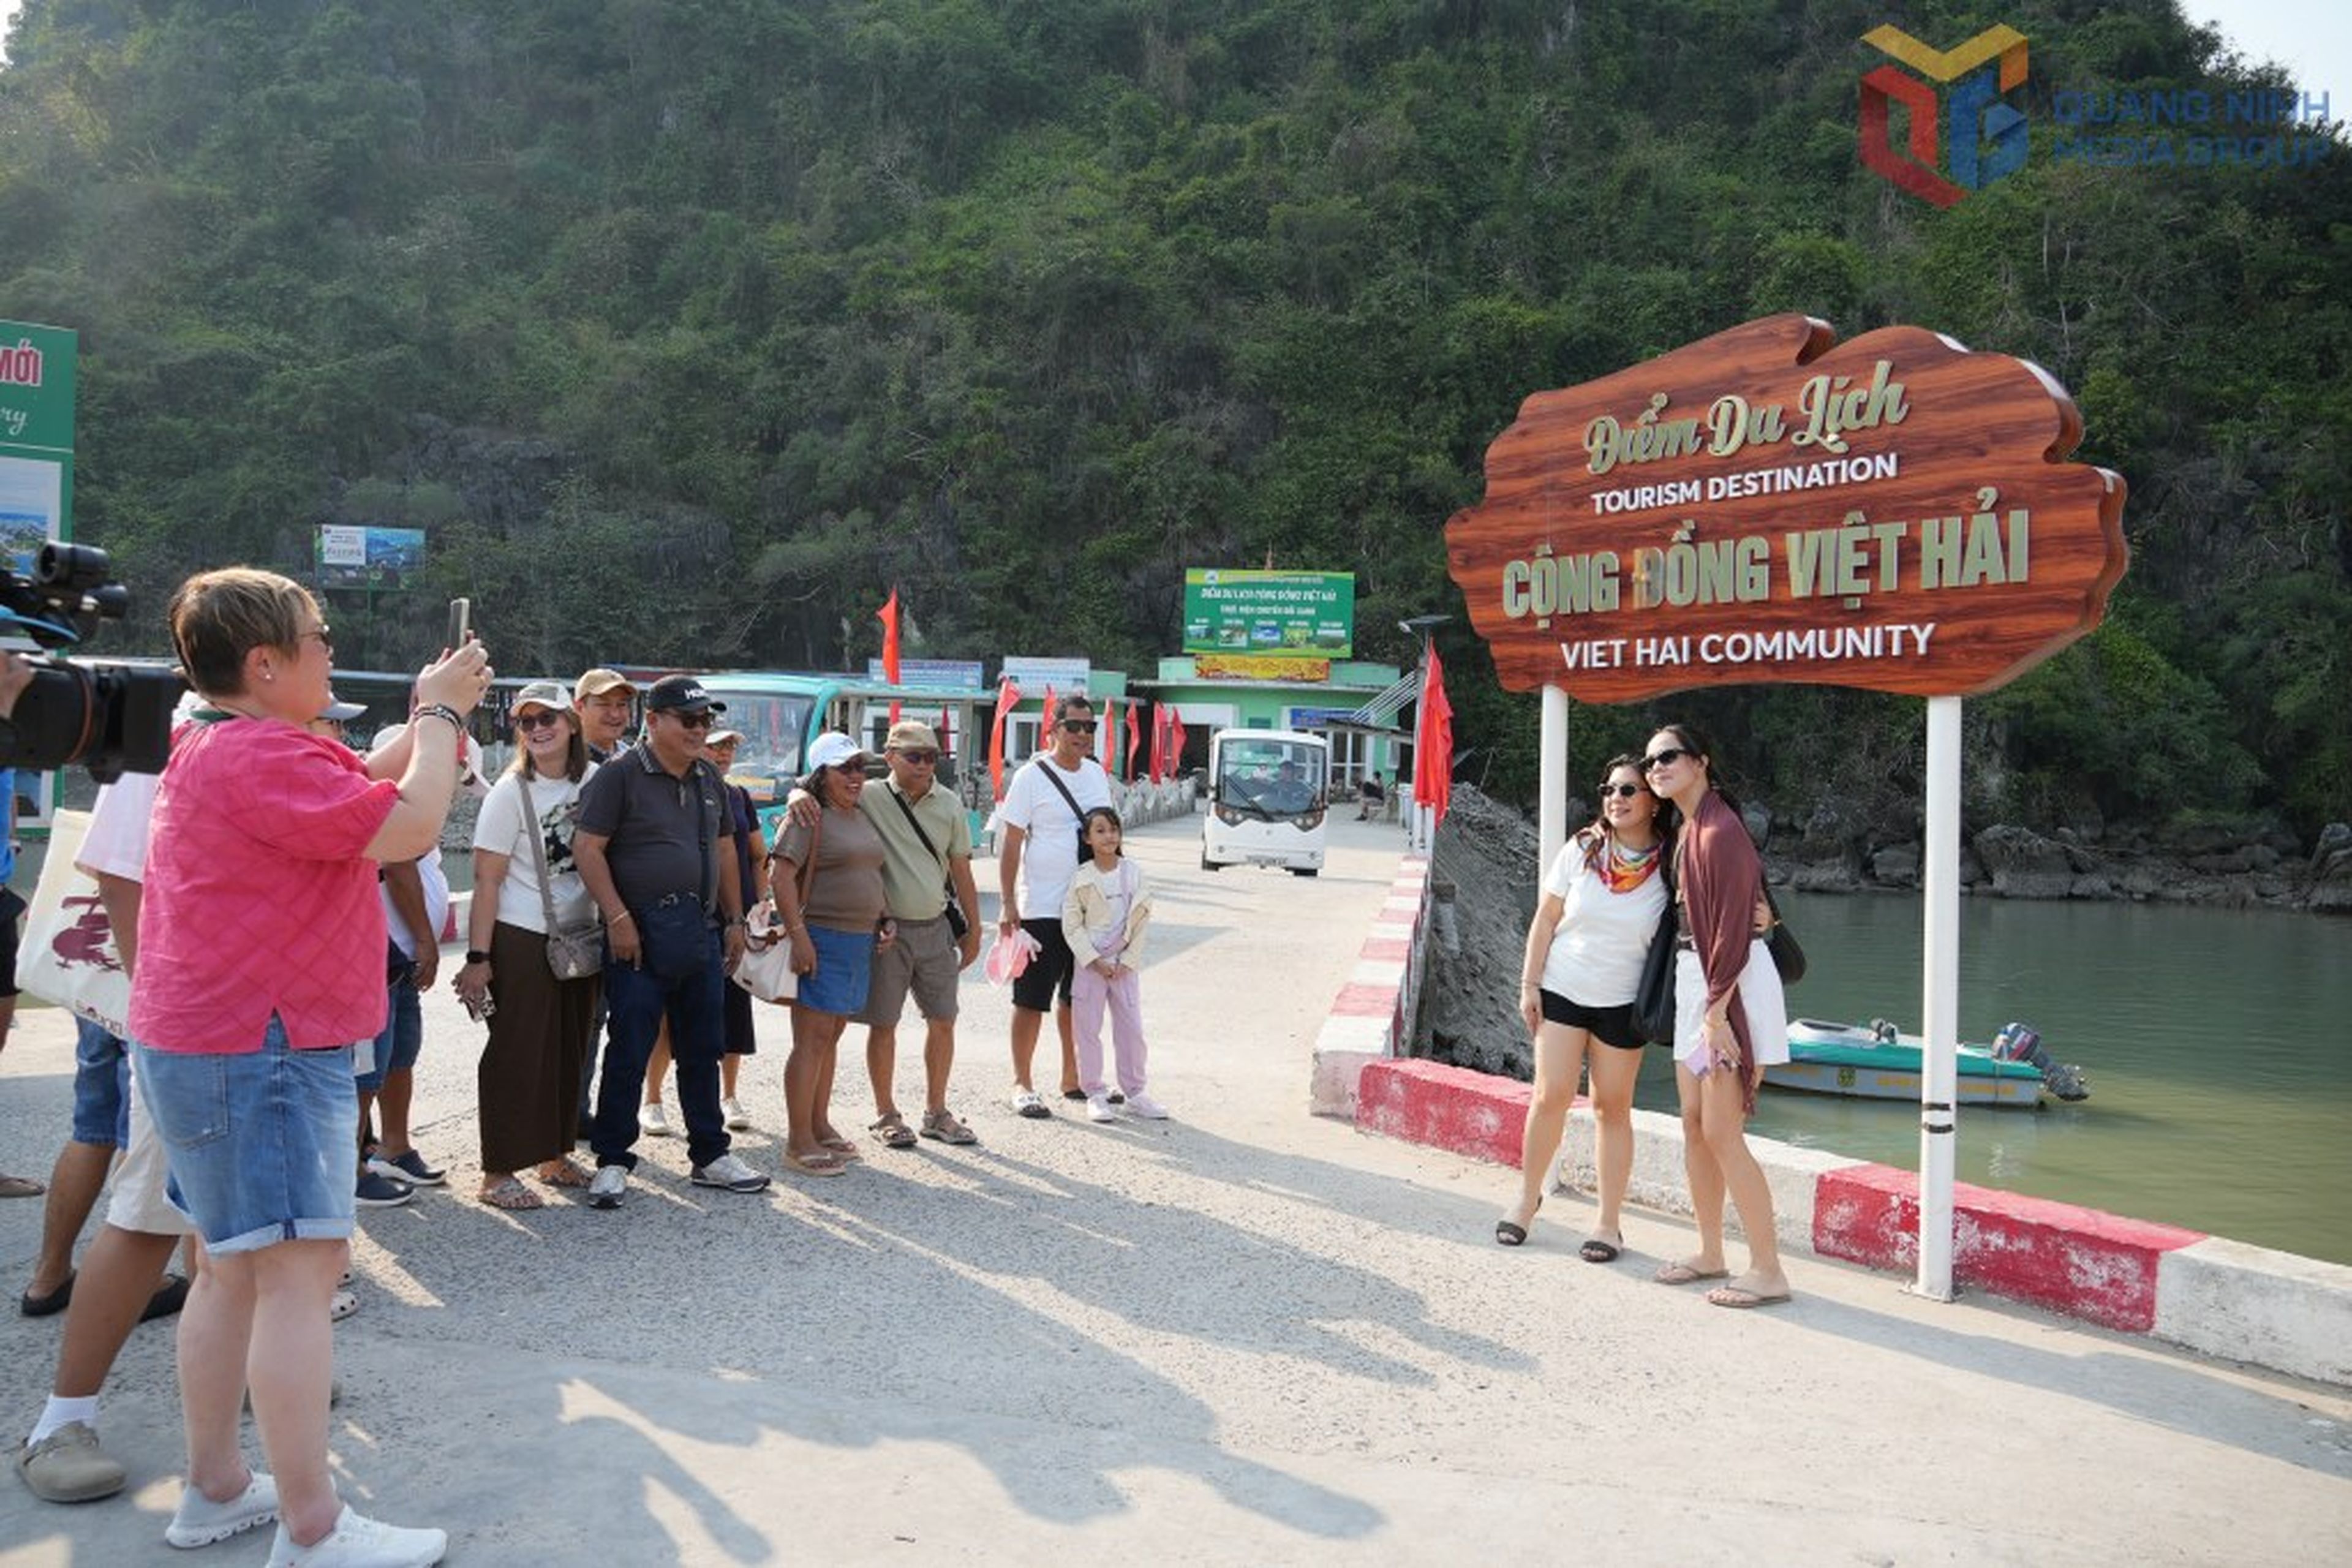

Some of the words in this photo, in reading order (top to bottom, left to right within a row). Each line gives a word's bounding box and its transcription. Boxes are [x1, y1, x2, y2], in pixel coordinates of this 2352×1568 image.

[1706, 394, 1786, 456] Du
[1790, 360, 1910, 454] Lịch
[1591, 479, 1701, 515] TOURISM
[1707, 452, 1899, 502] DESTINATION
[1502, 543, 1620, 630] CỘNG
[1632, 519, 1770, 610] ĐỒNG
[1785, 510, 1908, 609] VIỆT
[1920, 486, 2029, 590] HẢI
[1560, 638, 1629, 670] VIET
[1635, 635, 1691, 666] HAI
[1700, 622, 1936, 664] COMMUNITY
